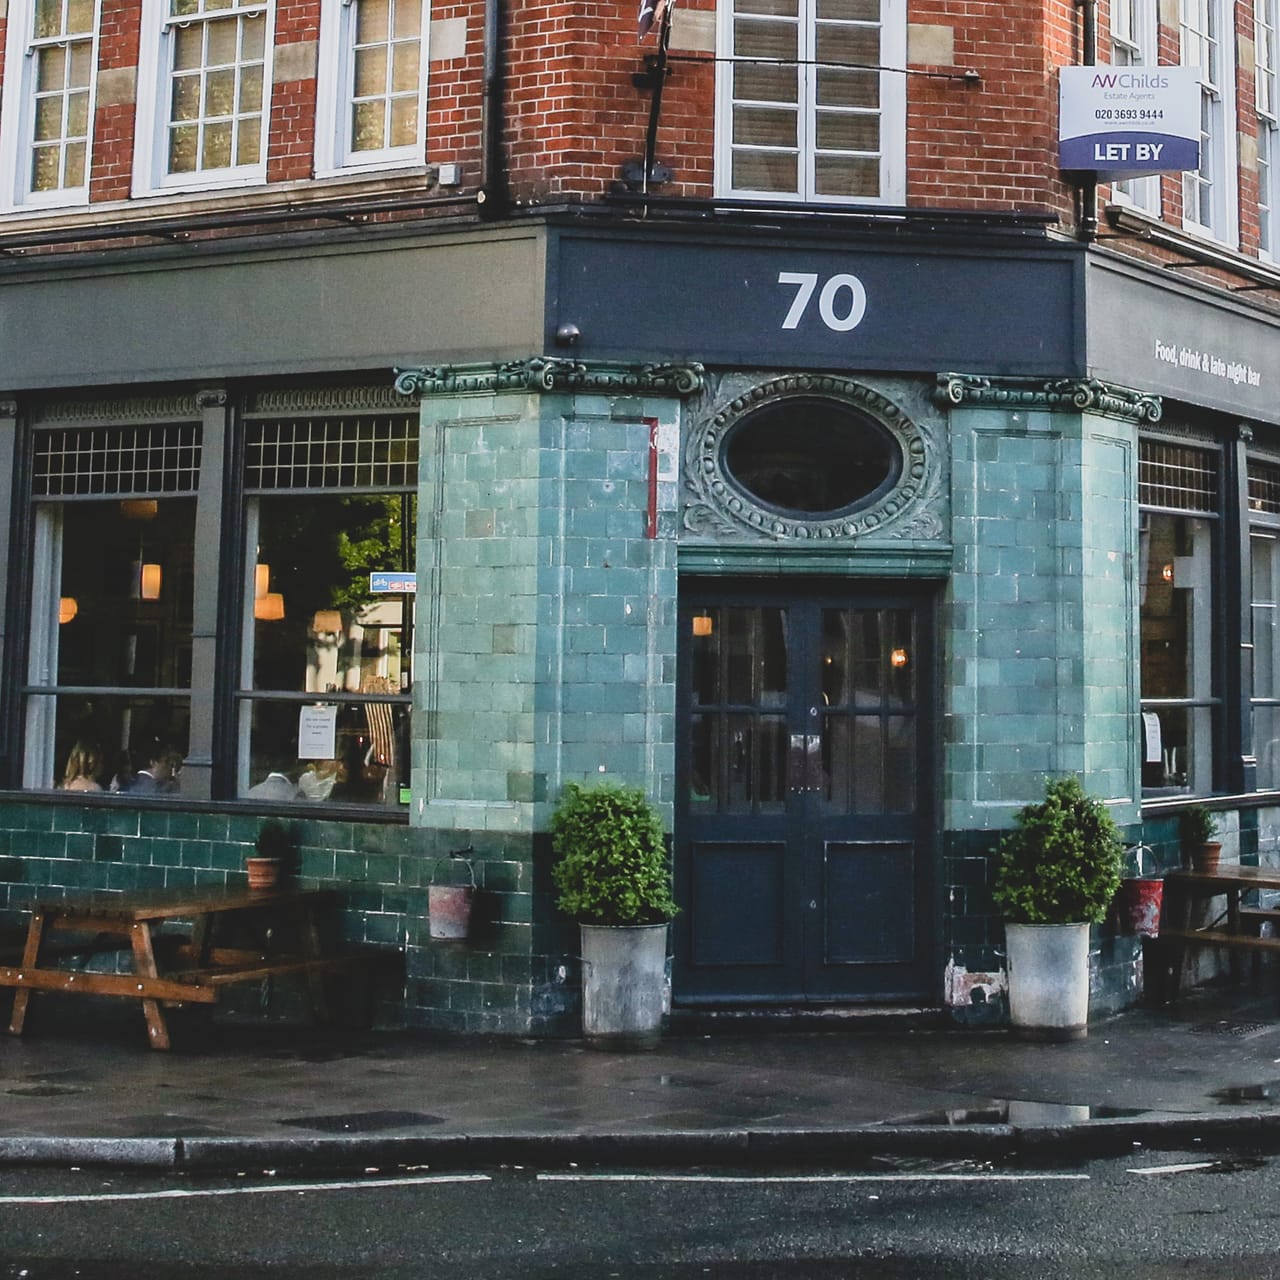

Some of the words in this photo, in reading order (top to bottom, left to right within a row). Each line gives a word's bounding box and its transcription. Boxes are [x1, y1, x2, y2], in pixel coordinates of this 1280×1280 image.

[1095, 109, 1113, 120] 020
[1114, 109, 1138, 120] 3693
[1139, 109, 1164, 120] 9444
[1094, 143, 1131, 161] LET
[1136, 143, 1164, 161] BY
[777, 271, 868, 332] 70
[1155, 339, 1178, 368] Food,
[1179, 347, 1201, 371] drink
[1201, 353, 1210, 373] &
[1210, 355, 1226, 377] late
[1226, 361, 1247, 384] night
[1247, 366, 1261, 387] bar
